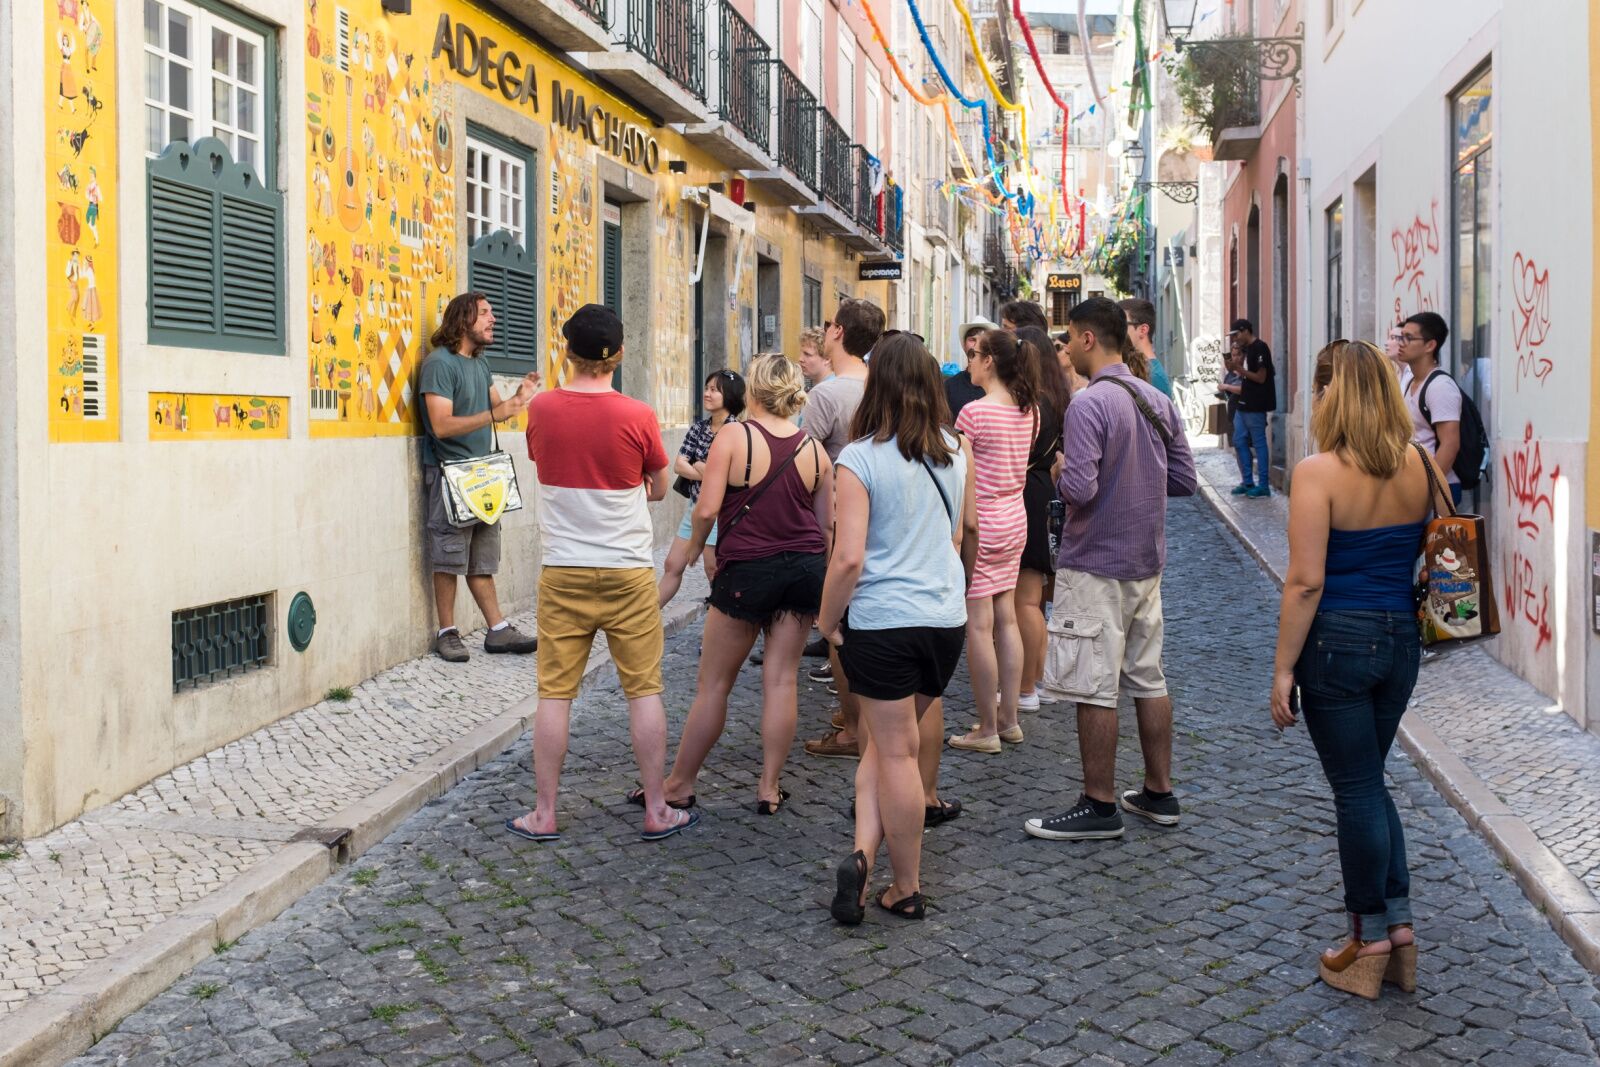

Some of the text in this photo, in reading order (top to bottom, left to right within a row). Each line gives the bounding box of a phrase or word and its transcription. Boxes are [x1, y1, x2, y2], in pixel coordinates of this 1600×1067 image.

[432, 13, 659, 174] ADEGA MACHADO
[861, 269, 900, 279] esperança
